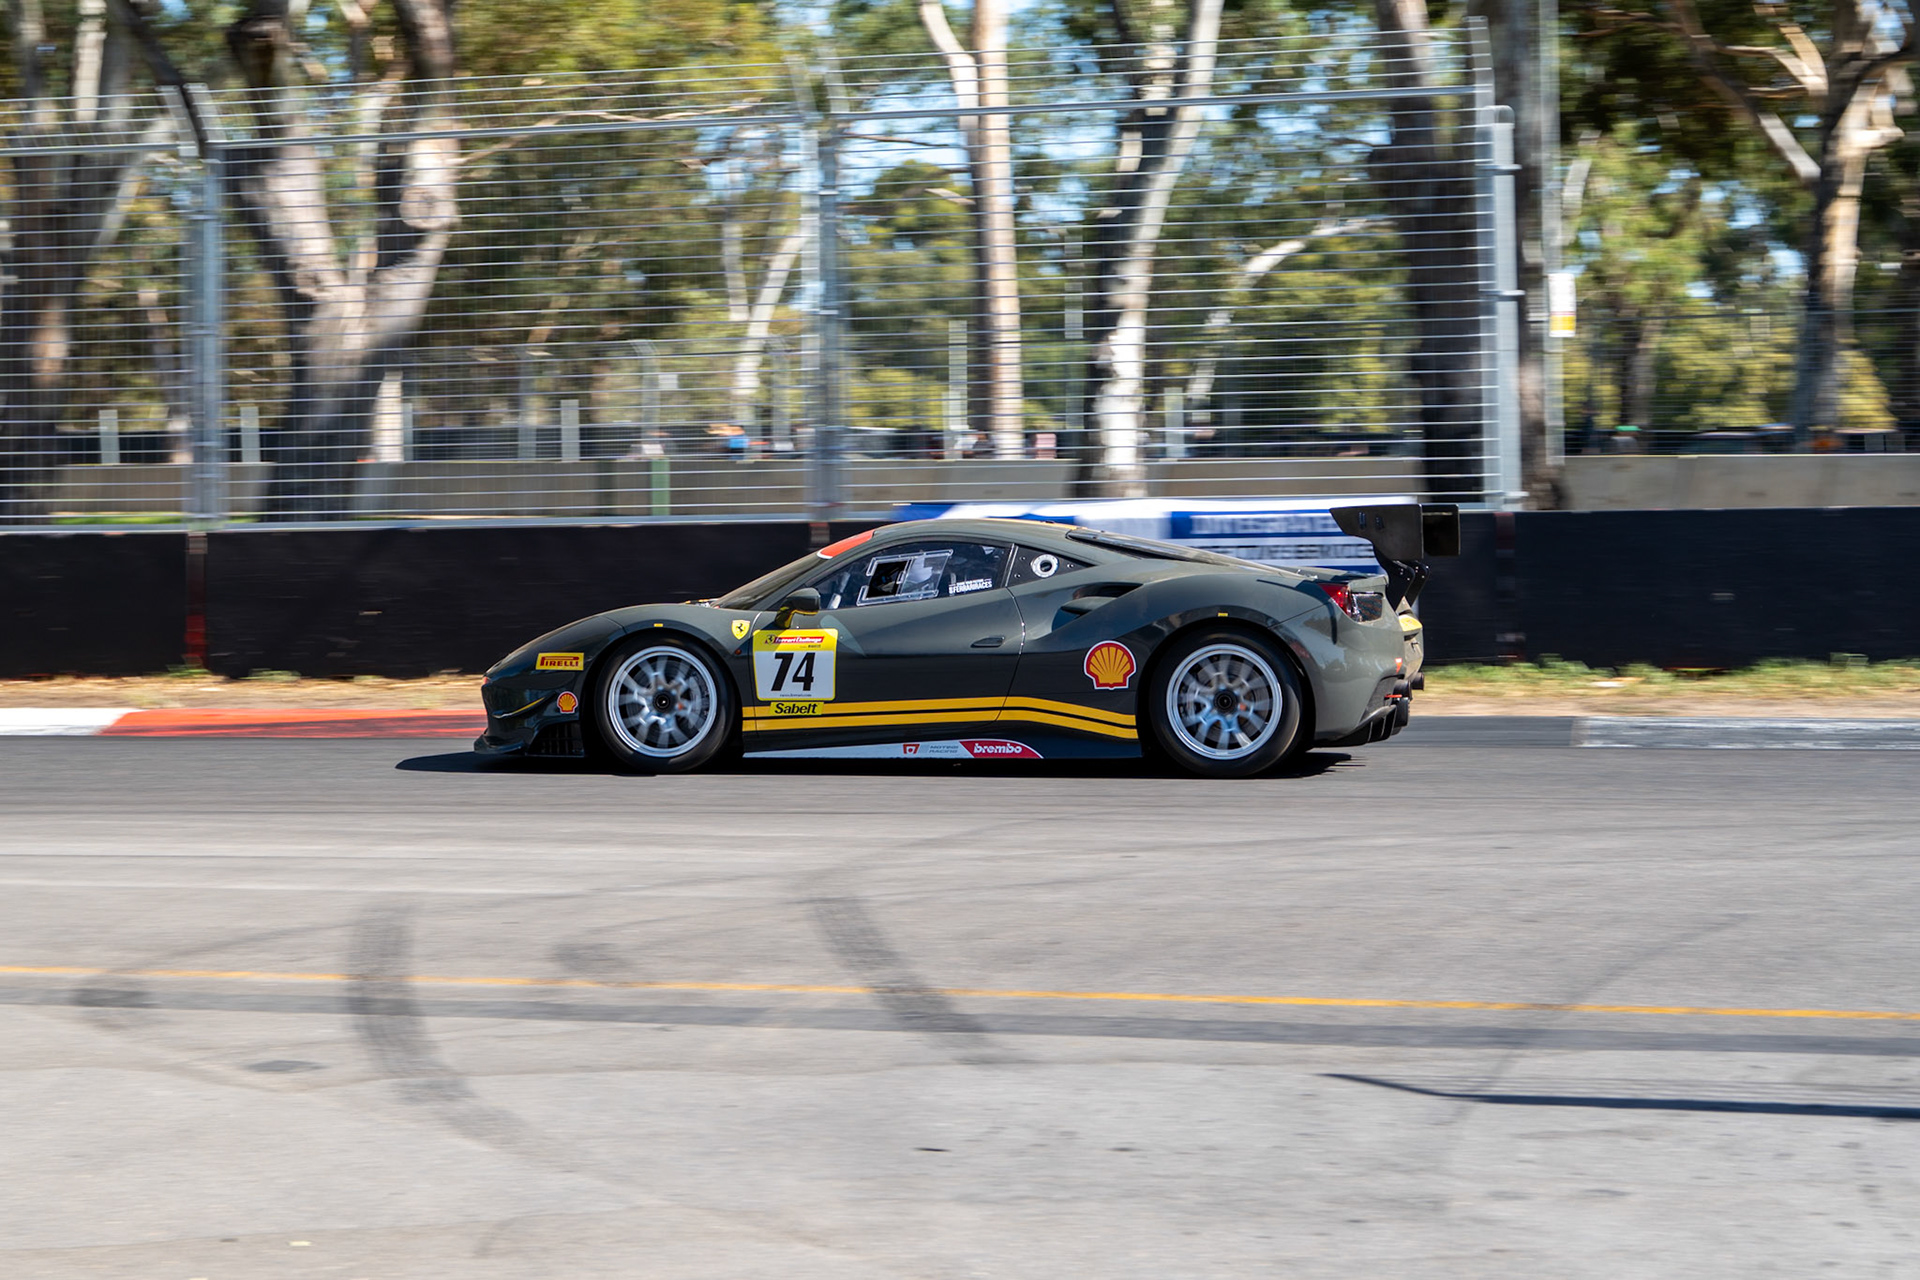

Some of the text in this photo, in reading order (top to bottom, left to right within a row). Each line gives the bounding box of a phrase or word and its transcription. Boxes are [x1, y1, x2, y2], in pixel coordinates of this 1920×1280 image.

[540, 656, 580, 667] PIRELLI
[771, 652, 816, 691] 74
[774, 703, 818, 714] Sabelt
[973, 743, 1023, 754] brembo
